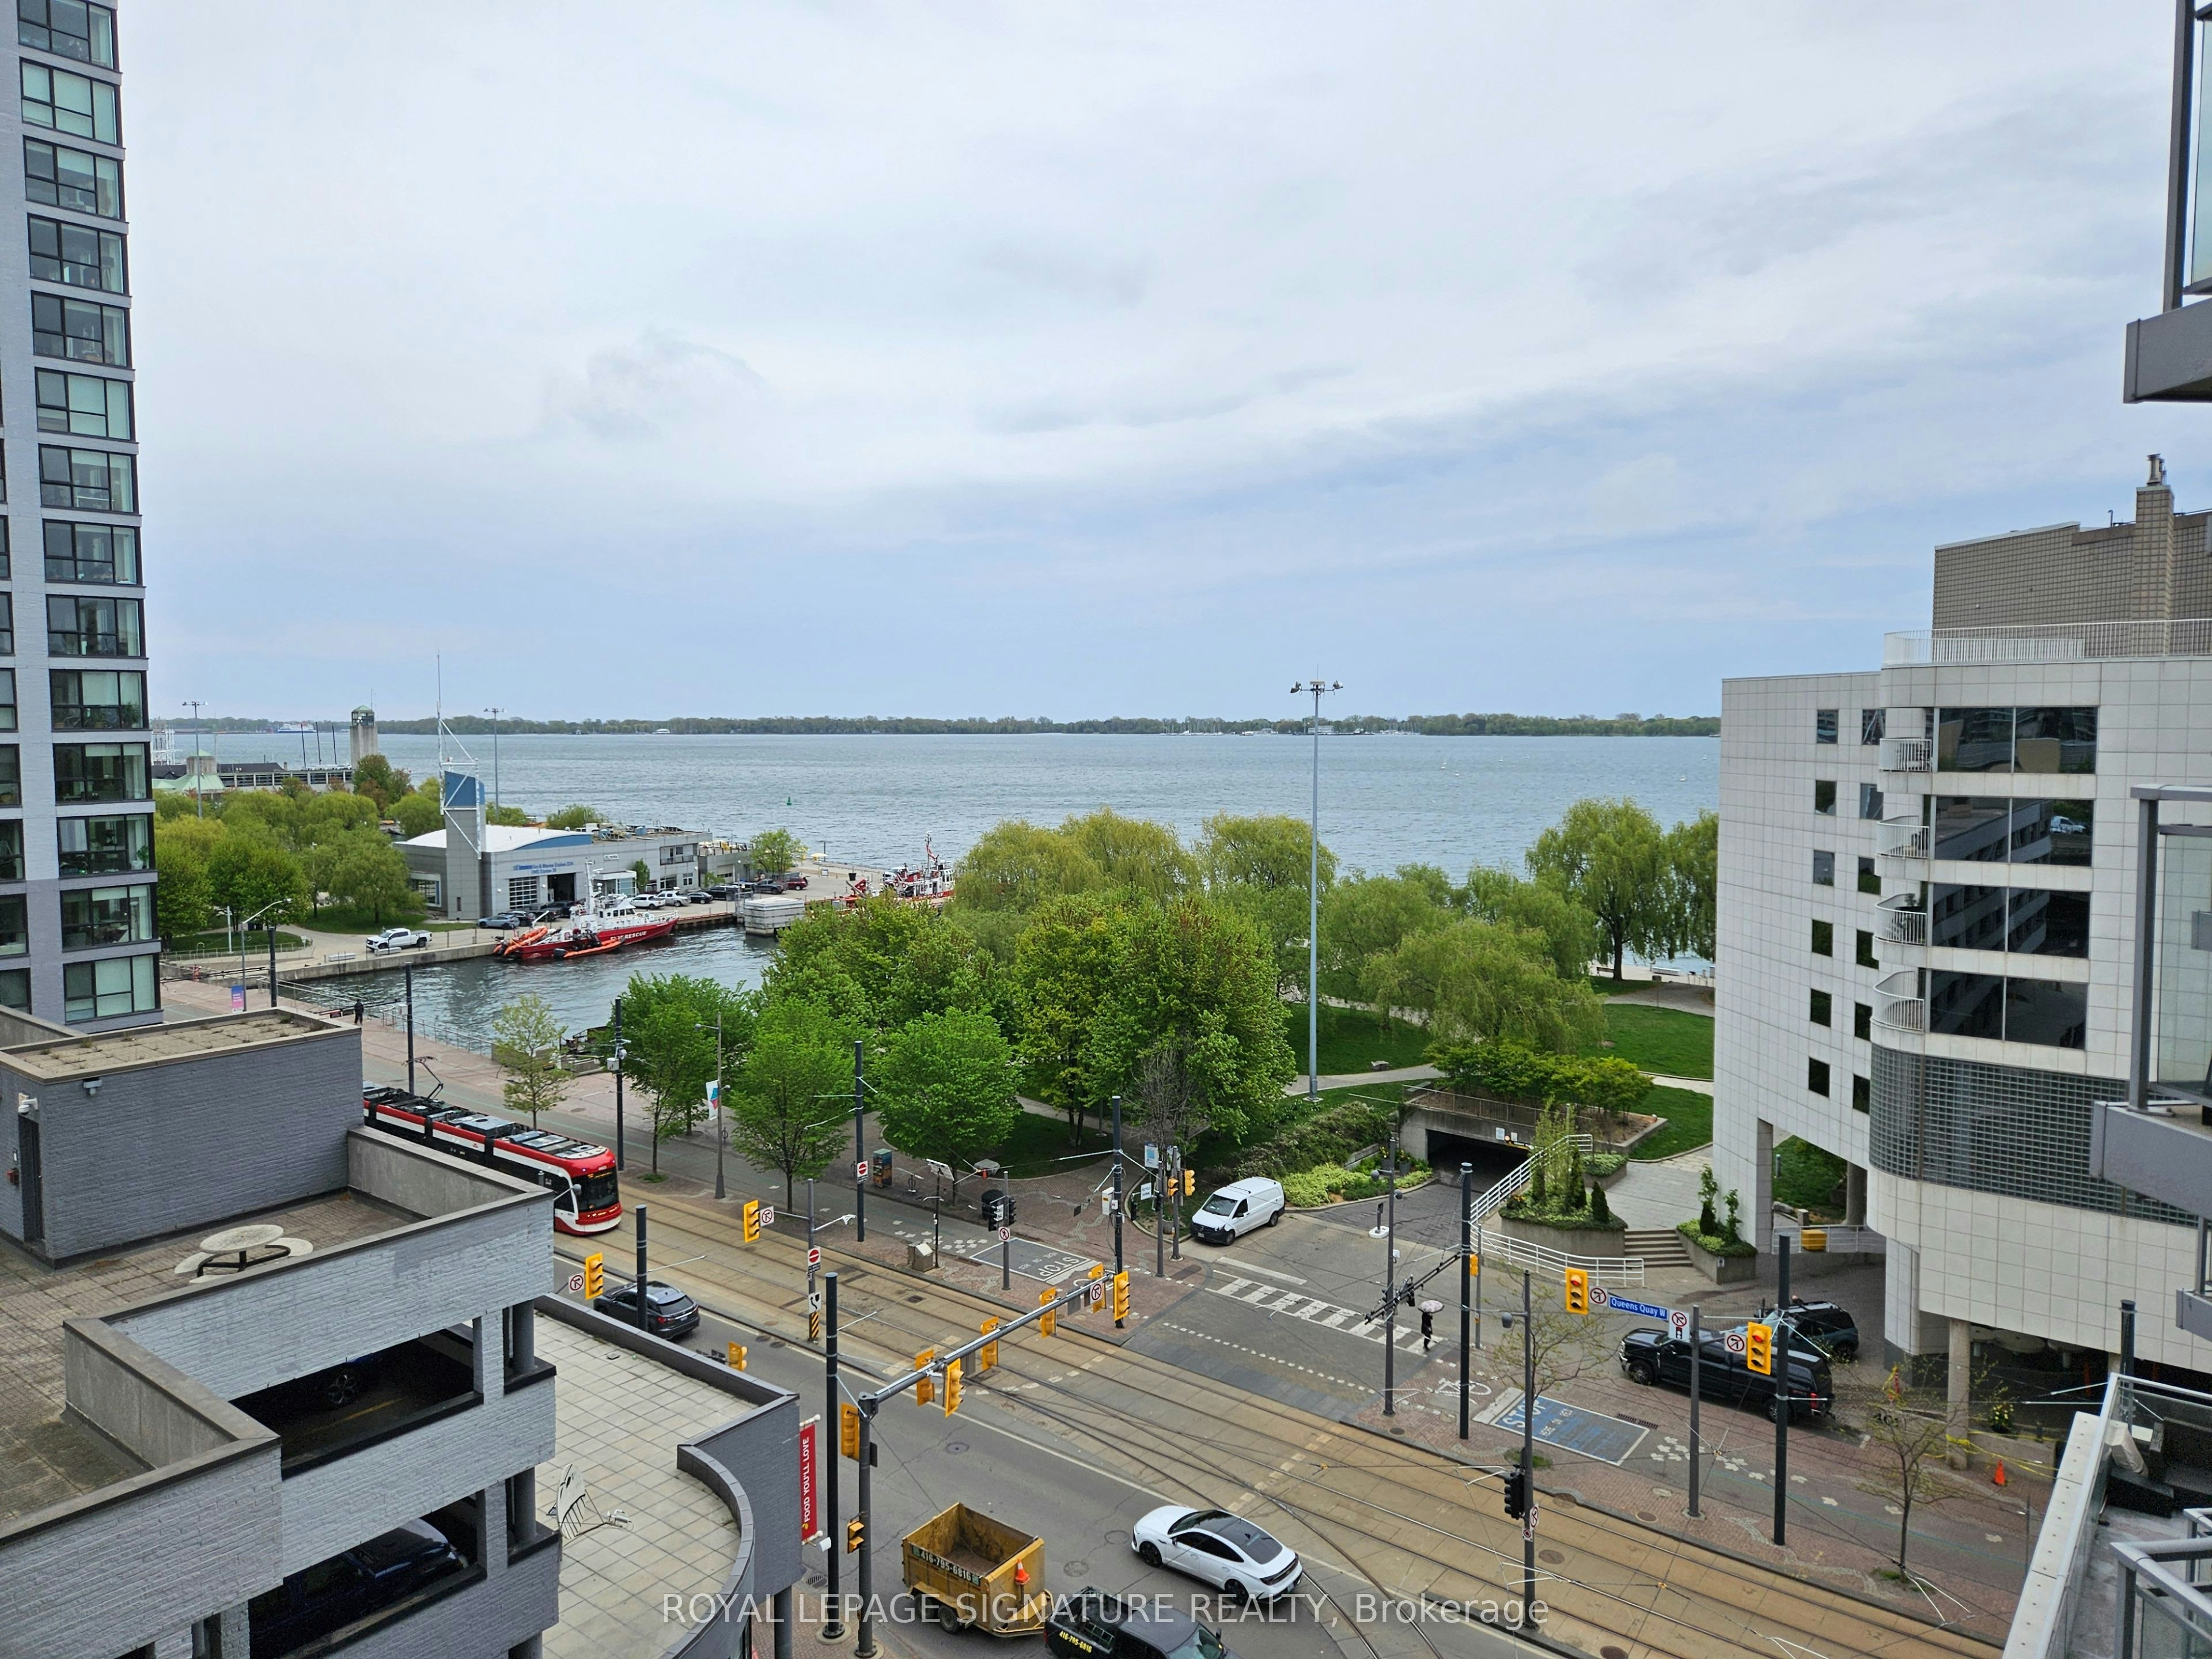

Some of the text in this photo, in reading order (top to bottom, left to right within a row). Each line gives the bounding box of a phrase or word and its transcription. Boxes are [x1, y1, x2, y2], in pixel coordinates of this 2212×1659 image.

[624, 931, 647, 939] RESCUE
[1038, 1256, 1080, 1277] STOP
[1611, 1298, 1666, 1317] Queens Quay W
[1502, 1399, 1546, 1428] STOP
[921, 1551, 971, 1581] 416-795-6816
